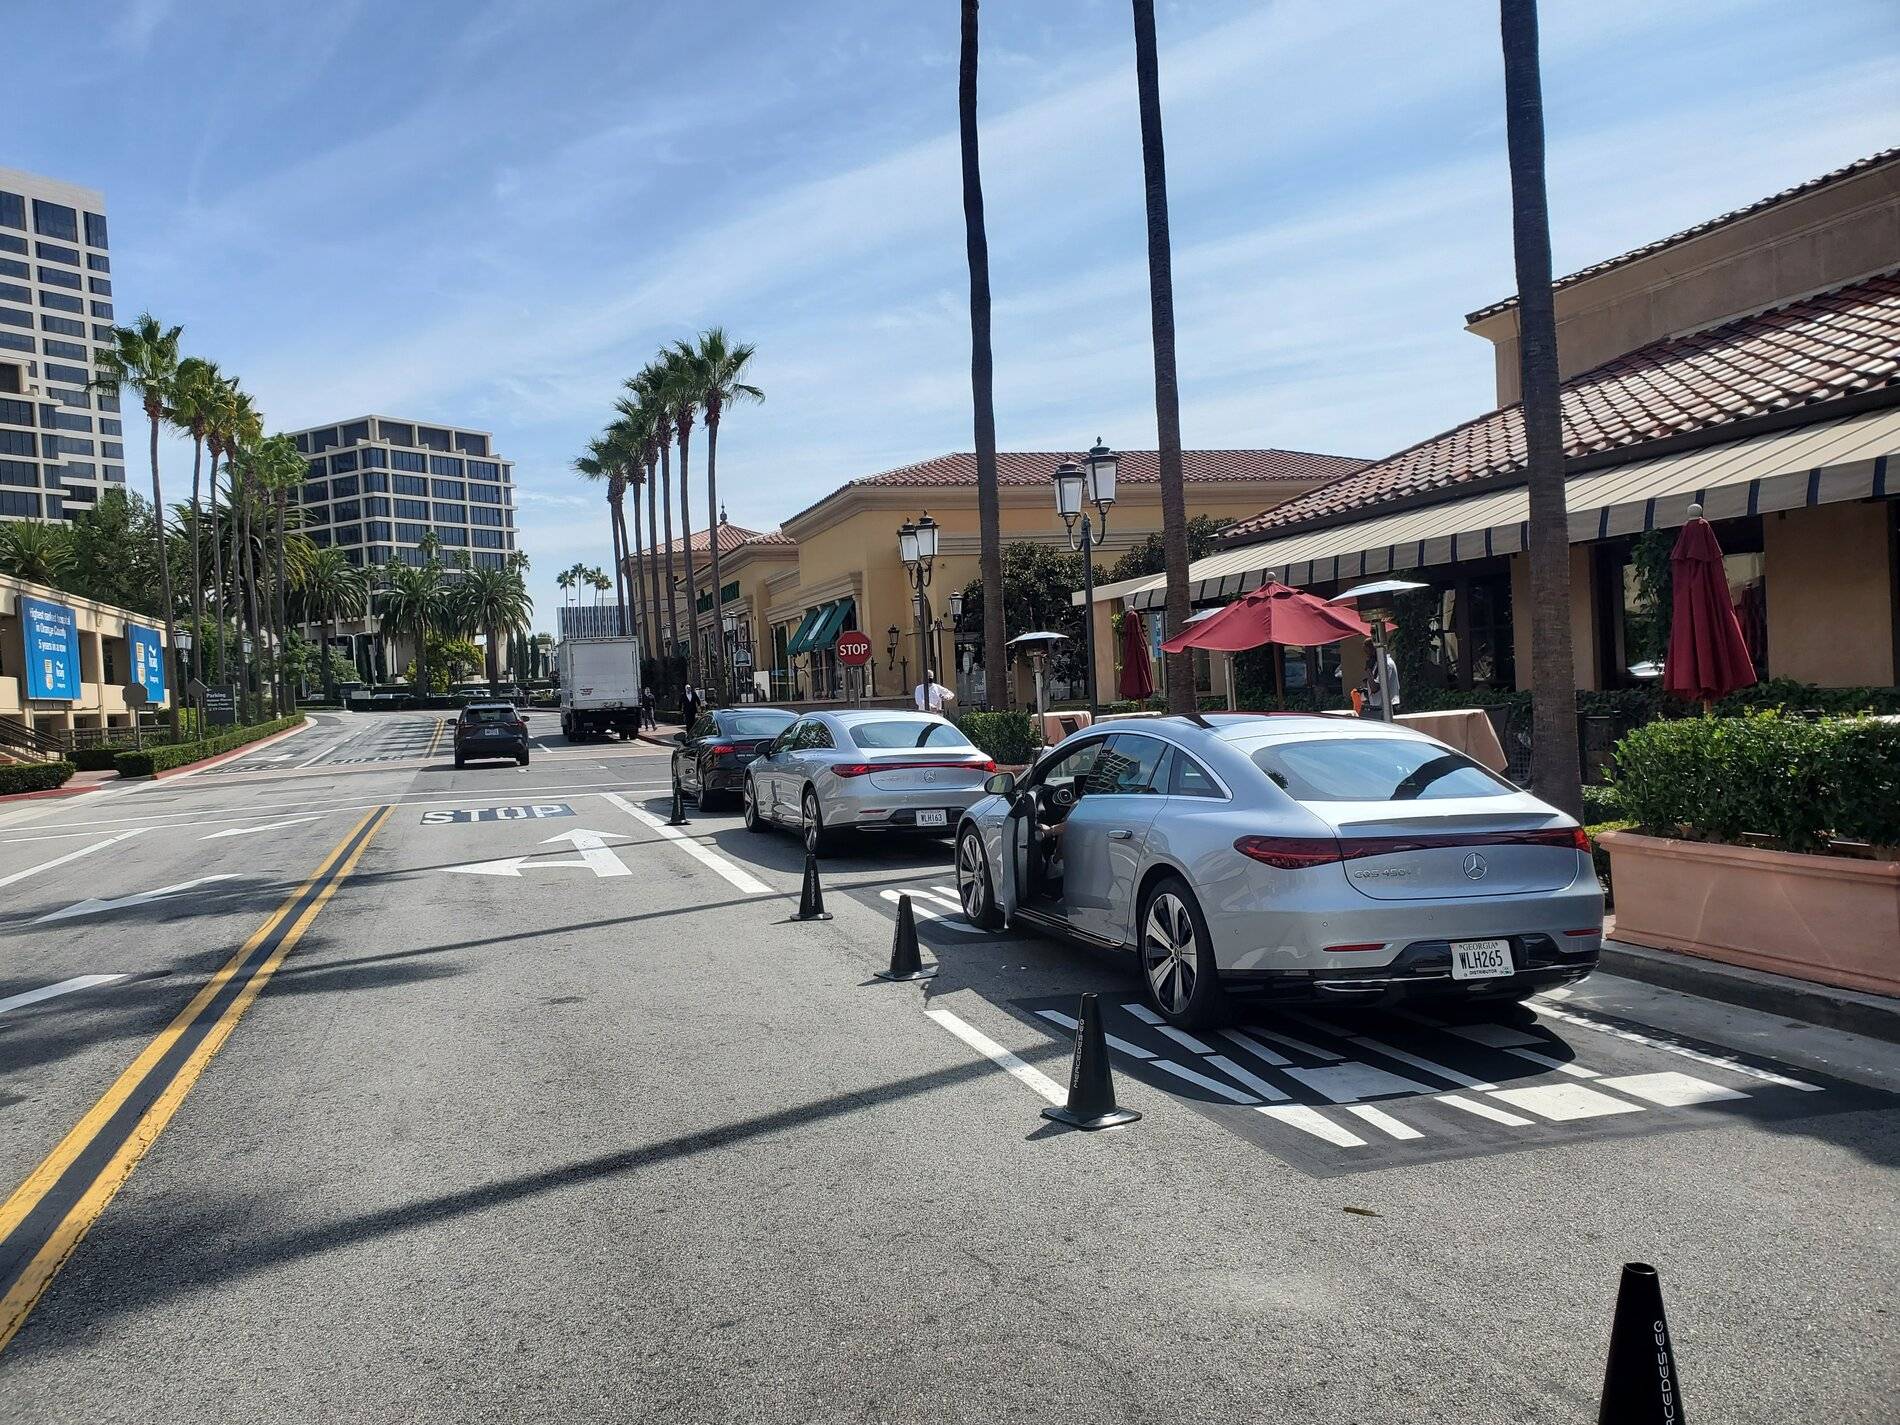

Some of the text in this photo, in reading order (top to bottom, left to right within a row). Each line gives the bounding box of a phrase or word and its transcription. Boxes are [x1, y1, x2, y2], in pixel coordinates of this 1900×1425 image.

[840, 643, 868, 655] STOP
[421, 804, 563, 825] STOP
[920, 813, 943, 822] WLH163
[1462, 942, 1496, 951] GEORGIA
[1459, 950, 1503, 969] WLH265
[1073, 1018, 1085, 1088] MERCEDES-EQ
